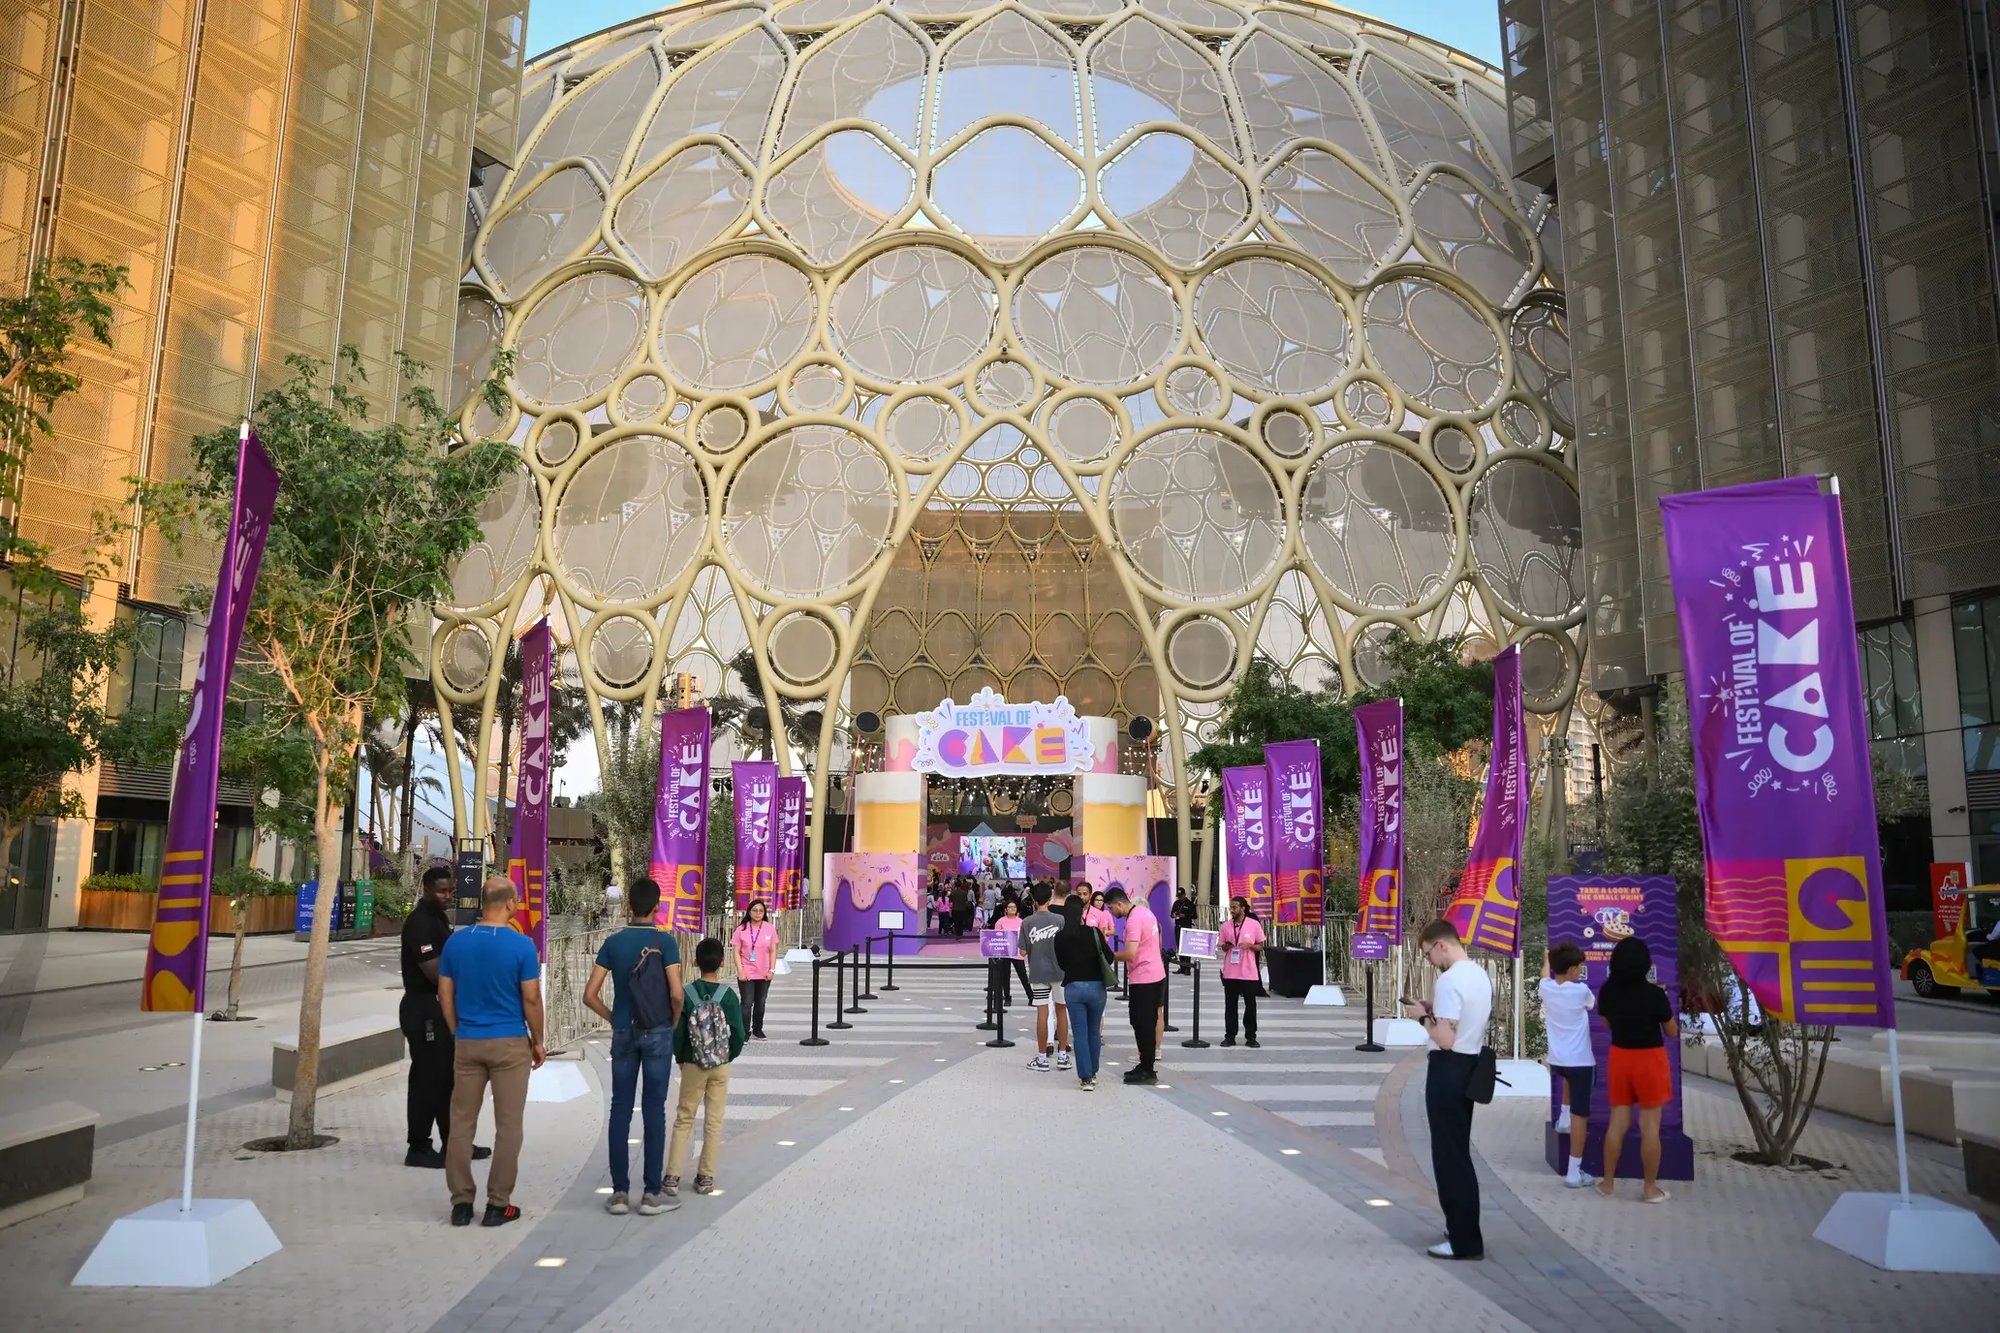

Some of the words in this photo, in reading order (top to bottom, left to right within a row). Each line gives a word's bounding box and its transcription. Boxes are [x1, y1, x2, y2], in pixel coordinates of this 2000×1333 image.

[1729, 620, 1755, 647] OF
[1753, 561, 1834, 773] CAKE
[1731, 648, 1763, 745] FESTIVAL
[525, 671, 546, 805] CAKE
[956, 709, 1014, 726] FESTIVAL
[1016, 710, 1031, 725] OF
[938, 726, 1067, 768] CAKE
[674, 767, 681, 777] OF
[679, 743, 703, 831] CAKE
[1376, 765, 1384, 778] OF
[1381, 737, 1399, 833] CAKE
[668, 778, 681, 819] FESTIVAL
[748, 798, 753, 806] OF
[752, 783, 770, 844] CAKE
[1238, 805, 1245, 813] OF
[1282, 792, 1291, 801] OF
[1291, 771, 1315, 843] CAKE
[1377, 779, 1385, 822] FESTIVAL
[744, 807, 753, 835] FESTIVAL
[784, 797, 800, 850] CAKE
[1237, 814, 1246, 842] FESTIVAL
[1244, 788, 1264, 850] CAKE
[1282, 802, 1294, 834] FESTIVAL
